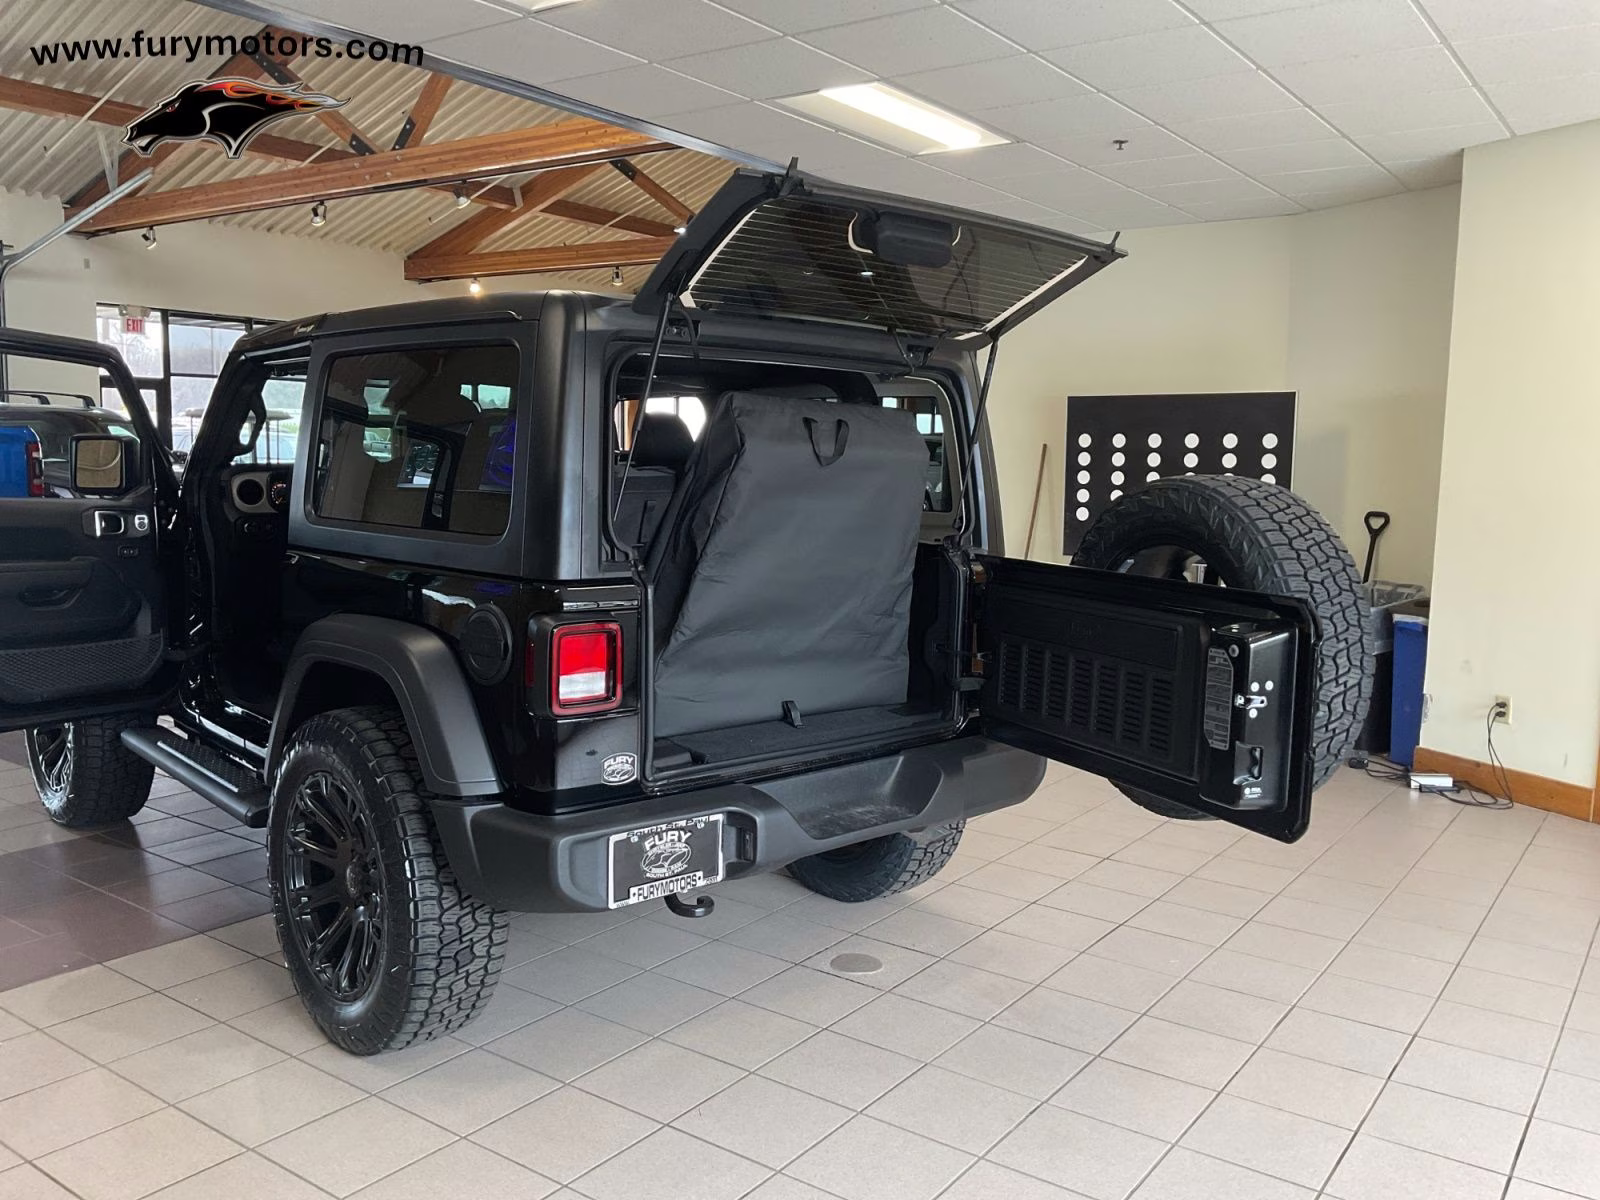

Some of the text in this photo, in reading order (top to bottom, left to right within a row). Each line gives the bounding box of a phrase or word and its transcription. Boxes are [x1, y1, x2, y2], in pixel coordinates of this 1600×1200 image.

[126, 318, 143, 332] EXIT
[604, 755, 634, 769] FURY
[644, 830, 692, 851] FURY
[637, 873, 697, 901] FURYMOTORS
